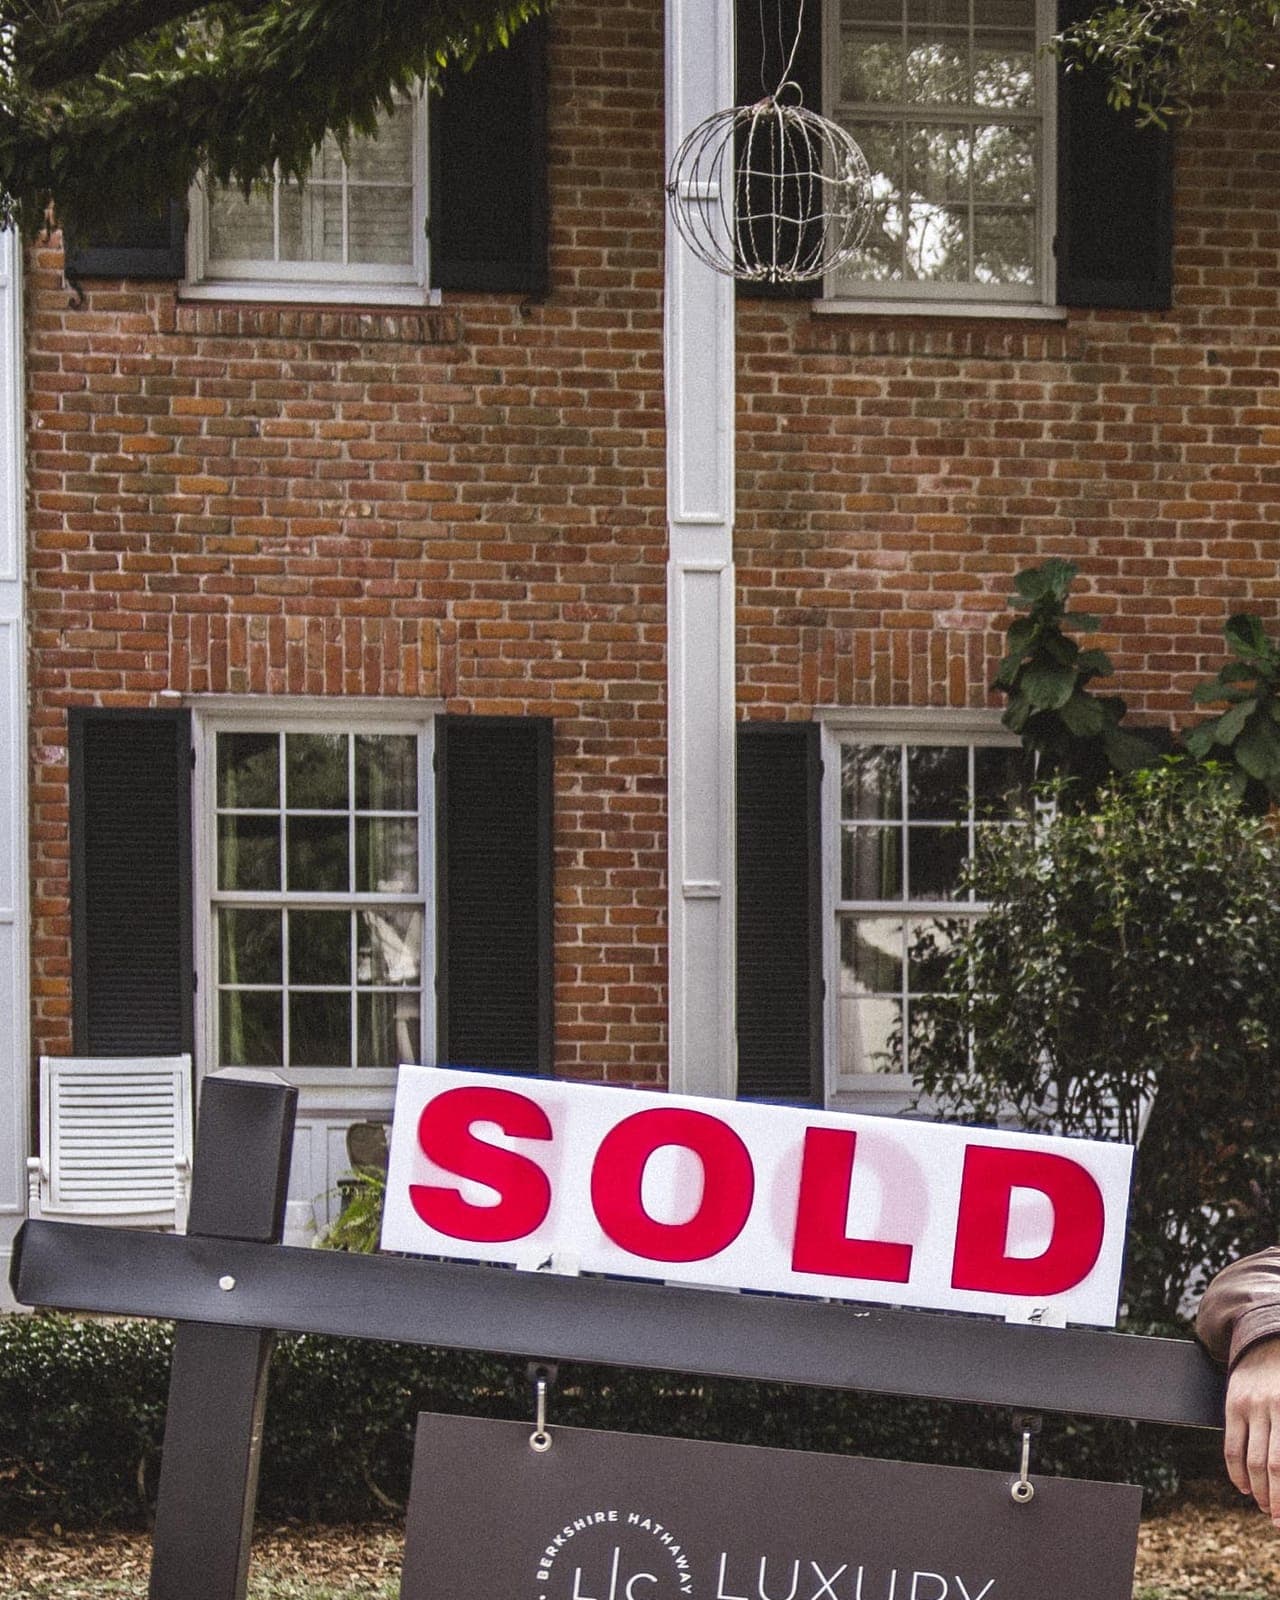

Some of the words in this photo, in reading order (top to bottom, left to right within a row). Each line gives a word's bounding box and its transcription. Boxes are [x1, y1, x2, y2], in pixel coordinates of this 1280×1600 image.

[409, 1086, 1105, 1297] SOLD
[536, 1510, 619, 1580] BERKSHIRE
[628, 1512, 693, 1594] HATHAWAY
